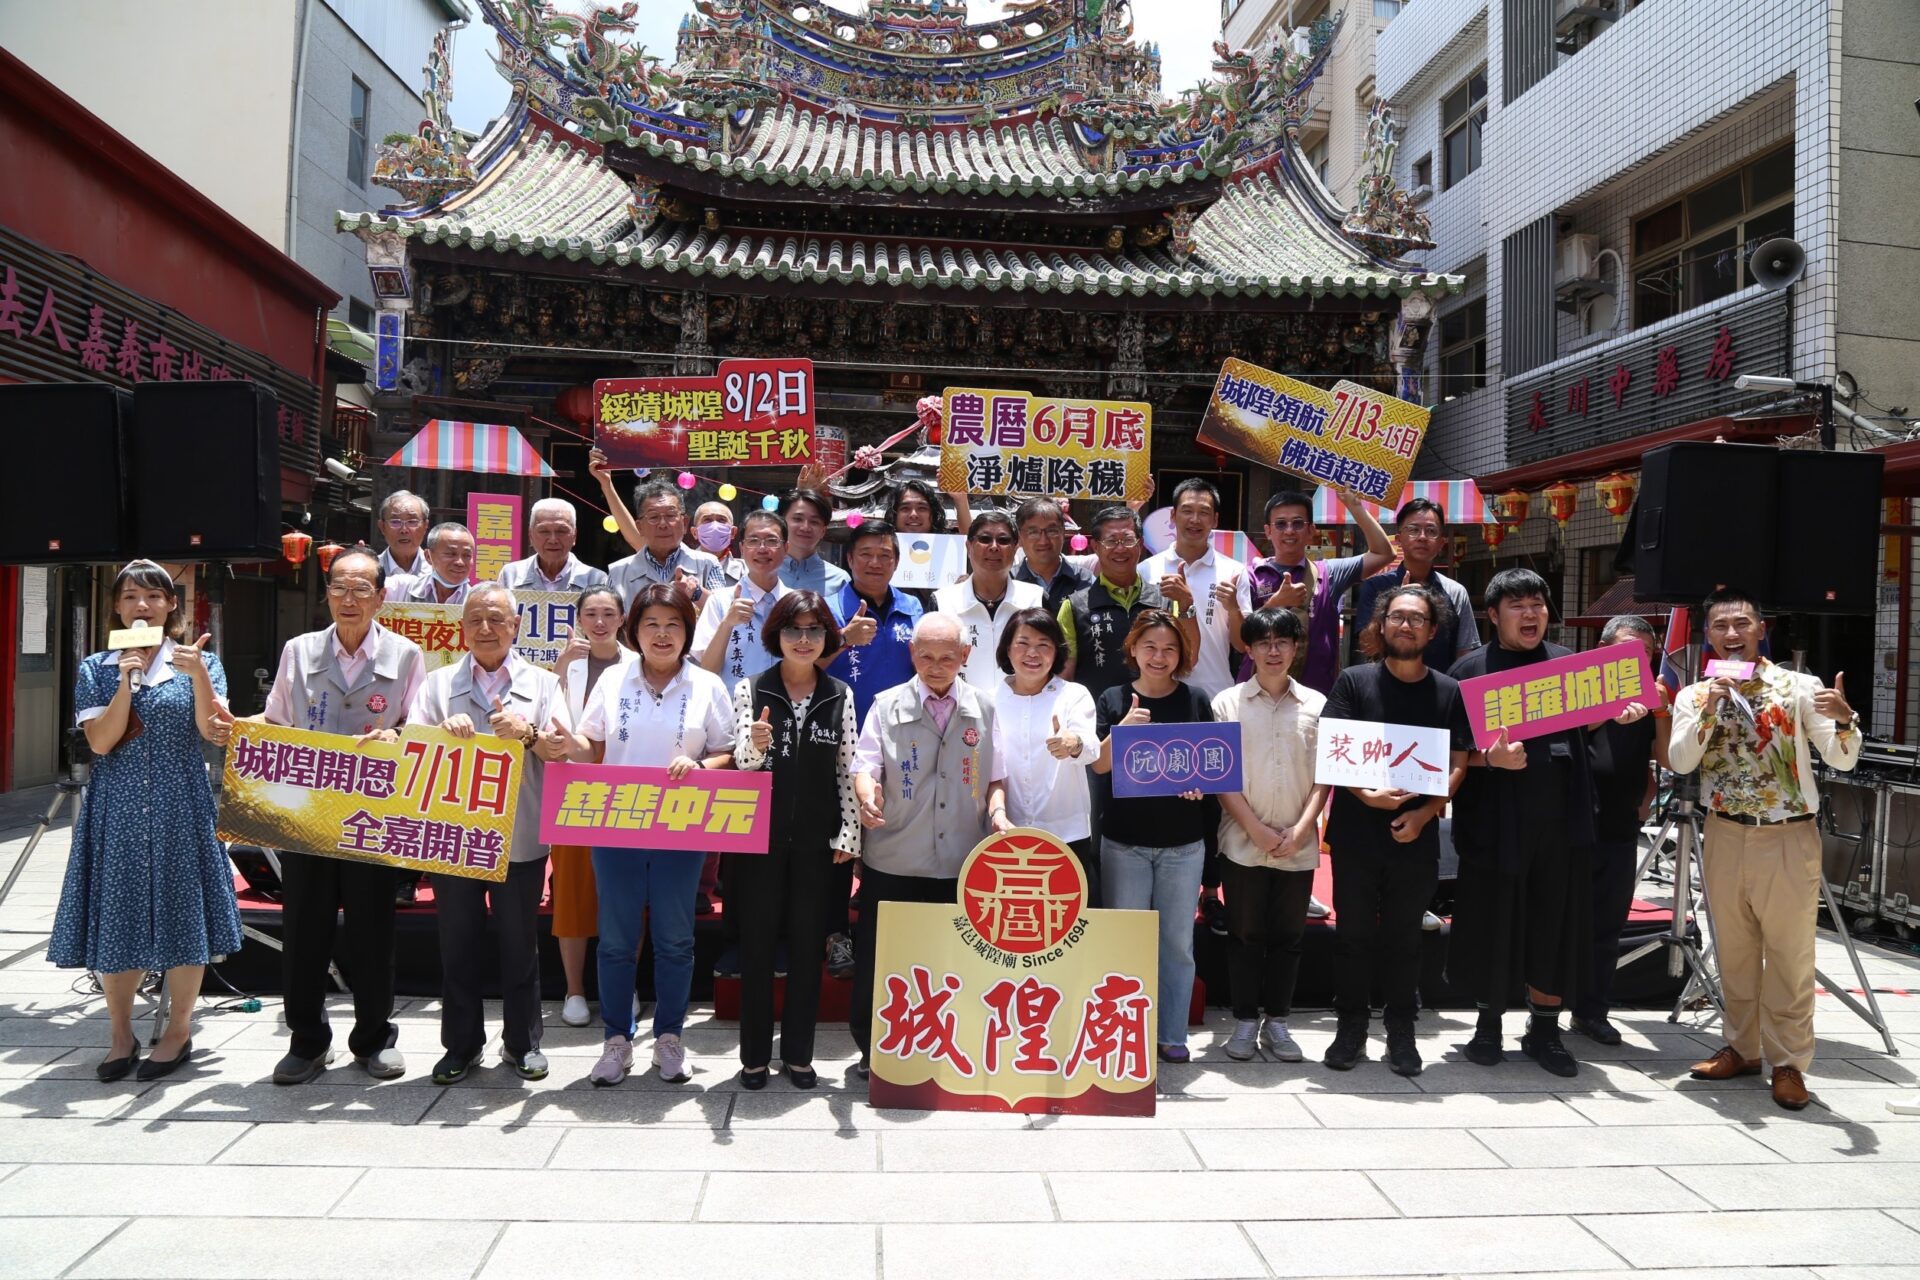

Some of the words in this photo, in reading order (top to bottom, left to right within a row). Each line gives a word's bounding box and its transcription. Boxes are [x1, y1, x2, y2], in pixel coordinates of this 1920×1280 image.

[600, 390, 724, 423] 綏靖城隍
[724, 369, 807, 422] 8/2日
[1528, 326, 1736, 433] 永川中藥房
[947, 393, 1146, 451] 農曆6月底
[1217, 373, 1329, 437] 城隍領航
[1327, 390, 1420, 459] 7/13~15日
[687, 428, 810, 461] 聖誕千秋
[1278, 436, 1393, 501] 佛道超渡
[966, 453, 1127, 498] 淨爐除穢
[968, 624, 979, 648] 議員
[1101, 612, 1113, 634] 議員
[730, 630, 745, 678] 李奕德
[848, 643, 862, 684] 家平
[618, 698, 632, 743] 張秀華
[1483, 657, 1643, 732] 諸羅城隍
[781, 717, 793, 757] 市議長
[1131, 746, 1225, 774] 阮劇團
[233, 737, 399, 799] 城隍開恩
[402, 741, 513, 816] 7/1日
[901, 760, 913, 800] 賴永川
[555, 780, 761, 835] 慈悲中元
[338, 809, 505, 870] 全嘉開普
[952, 915, 1018, 969] 嘉邑城隍廟
[1022, 947, 1064, 968] Since
[1062, 917, 1090, 950] 1694
[877, 965, 1152, 1081] 城隍廟
